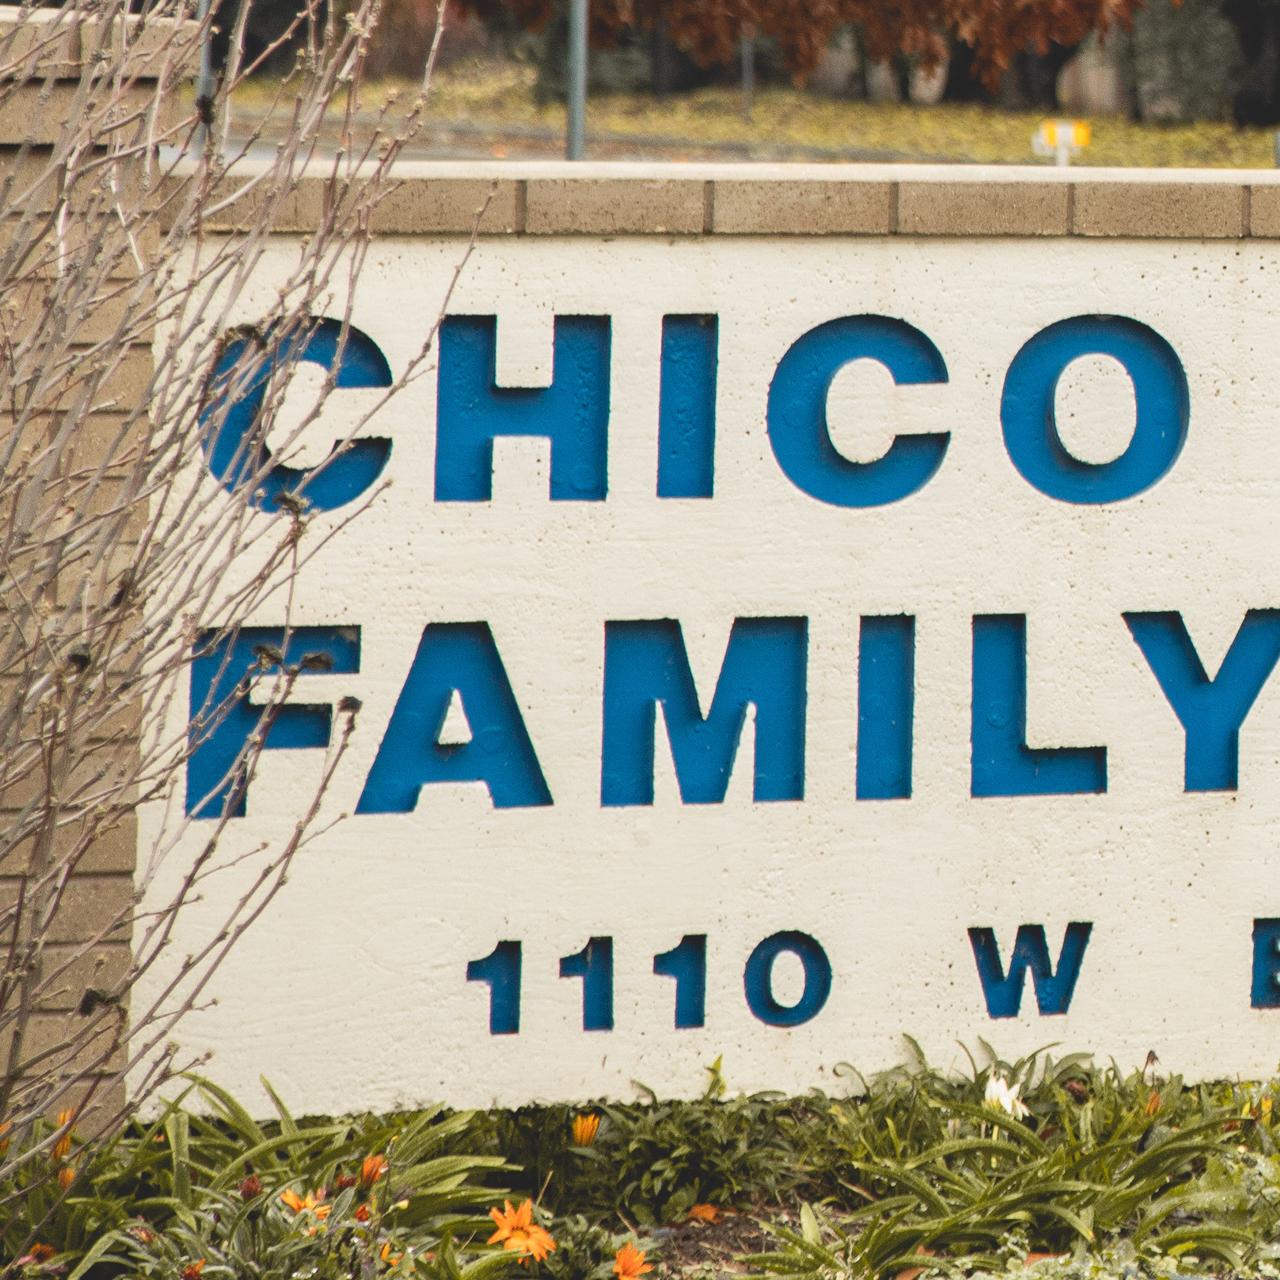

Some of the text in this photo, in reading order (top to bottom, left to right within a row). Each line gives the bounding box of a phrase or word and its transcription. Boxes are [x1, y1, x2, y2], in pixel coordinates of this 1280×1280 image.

[200, 314, 1190, 512] CHICO
[467, 929, 833, 1034] 1110
[967, 921, 1093, 1017] W
